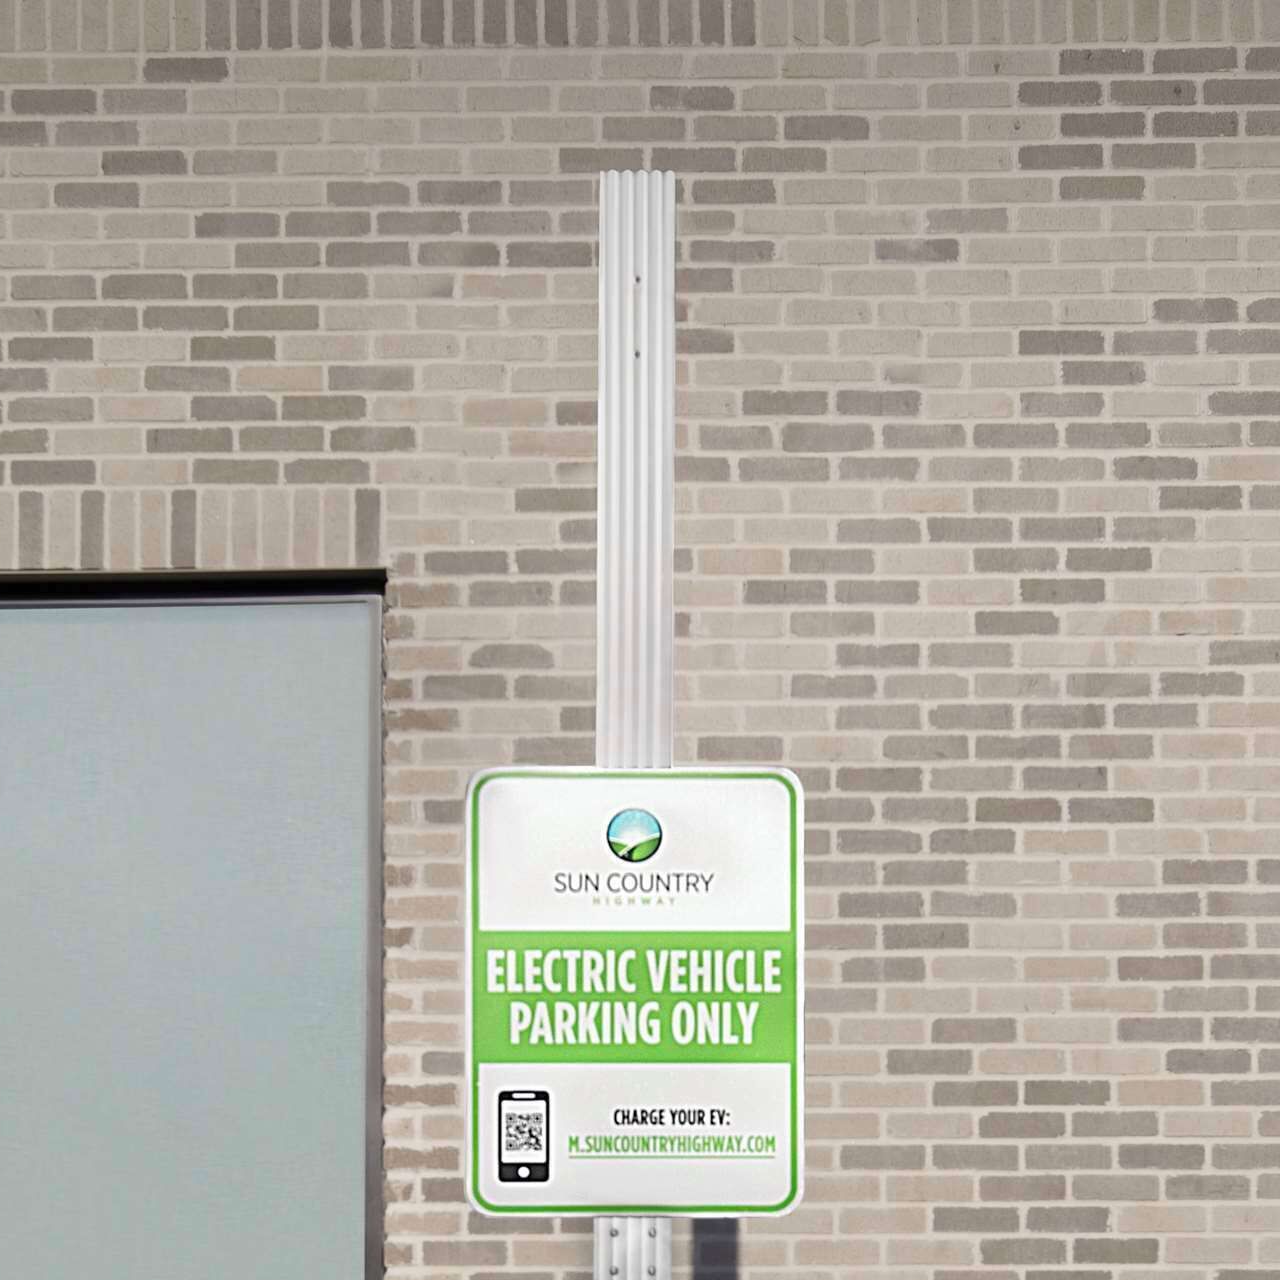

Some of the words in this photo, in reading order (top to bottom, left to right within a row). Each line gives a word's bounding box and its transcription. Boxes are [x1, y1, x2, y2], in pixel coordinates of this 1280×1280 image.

[554, 872, 600, 893] SUN
[606, 872, 715, 893] COUNTRY
[592, 896, 676, 906] HIGHWAY
[486, 949, 637, 993] ELECTRIC
[645, 949, 782, 993] VEHICLE
[509, 1001, 662, 1045] PARKING
[671, 1001, 759, 1045] ONLY
[613, 1108, 665, 1126] CHARGE
[669, 1108, 706, 1126] YOUR
[709, 1108, 731, 1126] EV:
[568, 1135, 776, 1153] M.SUNCOUNTRYHIGHWAY.COM
